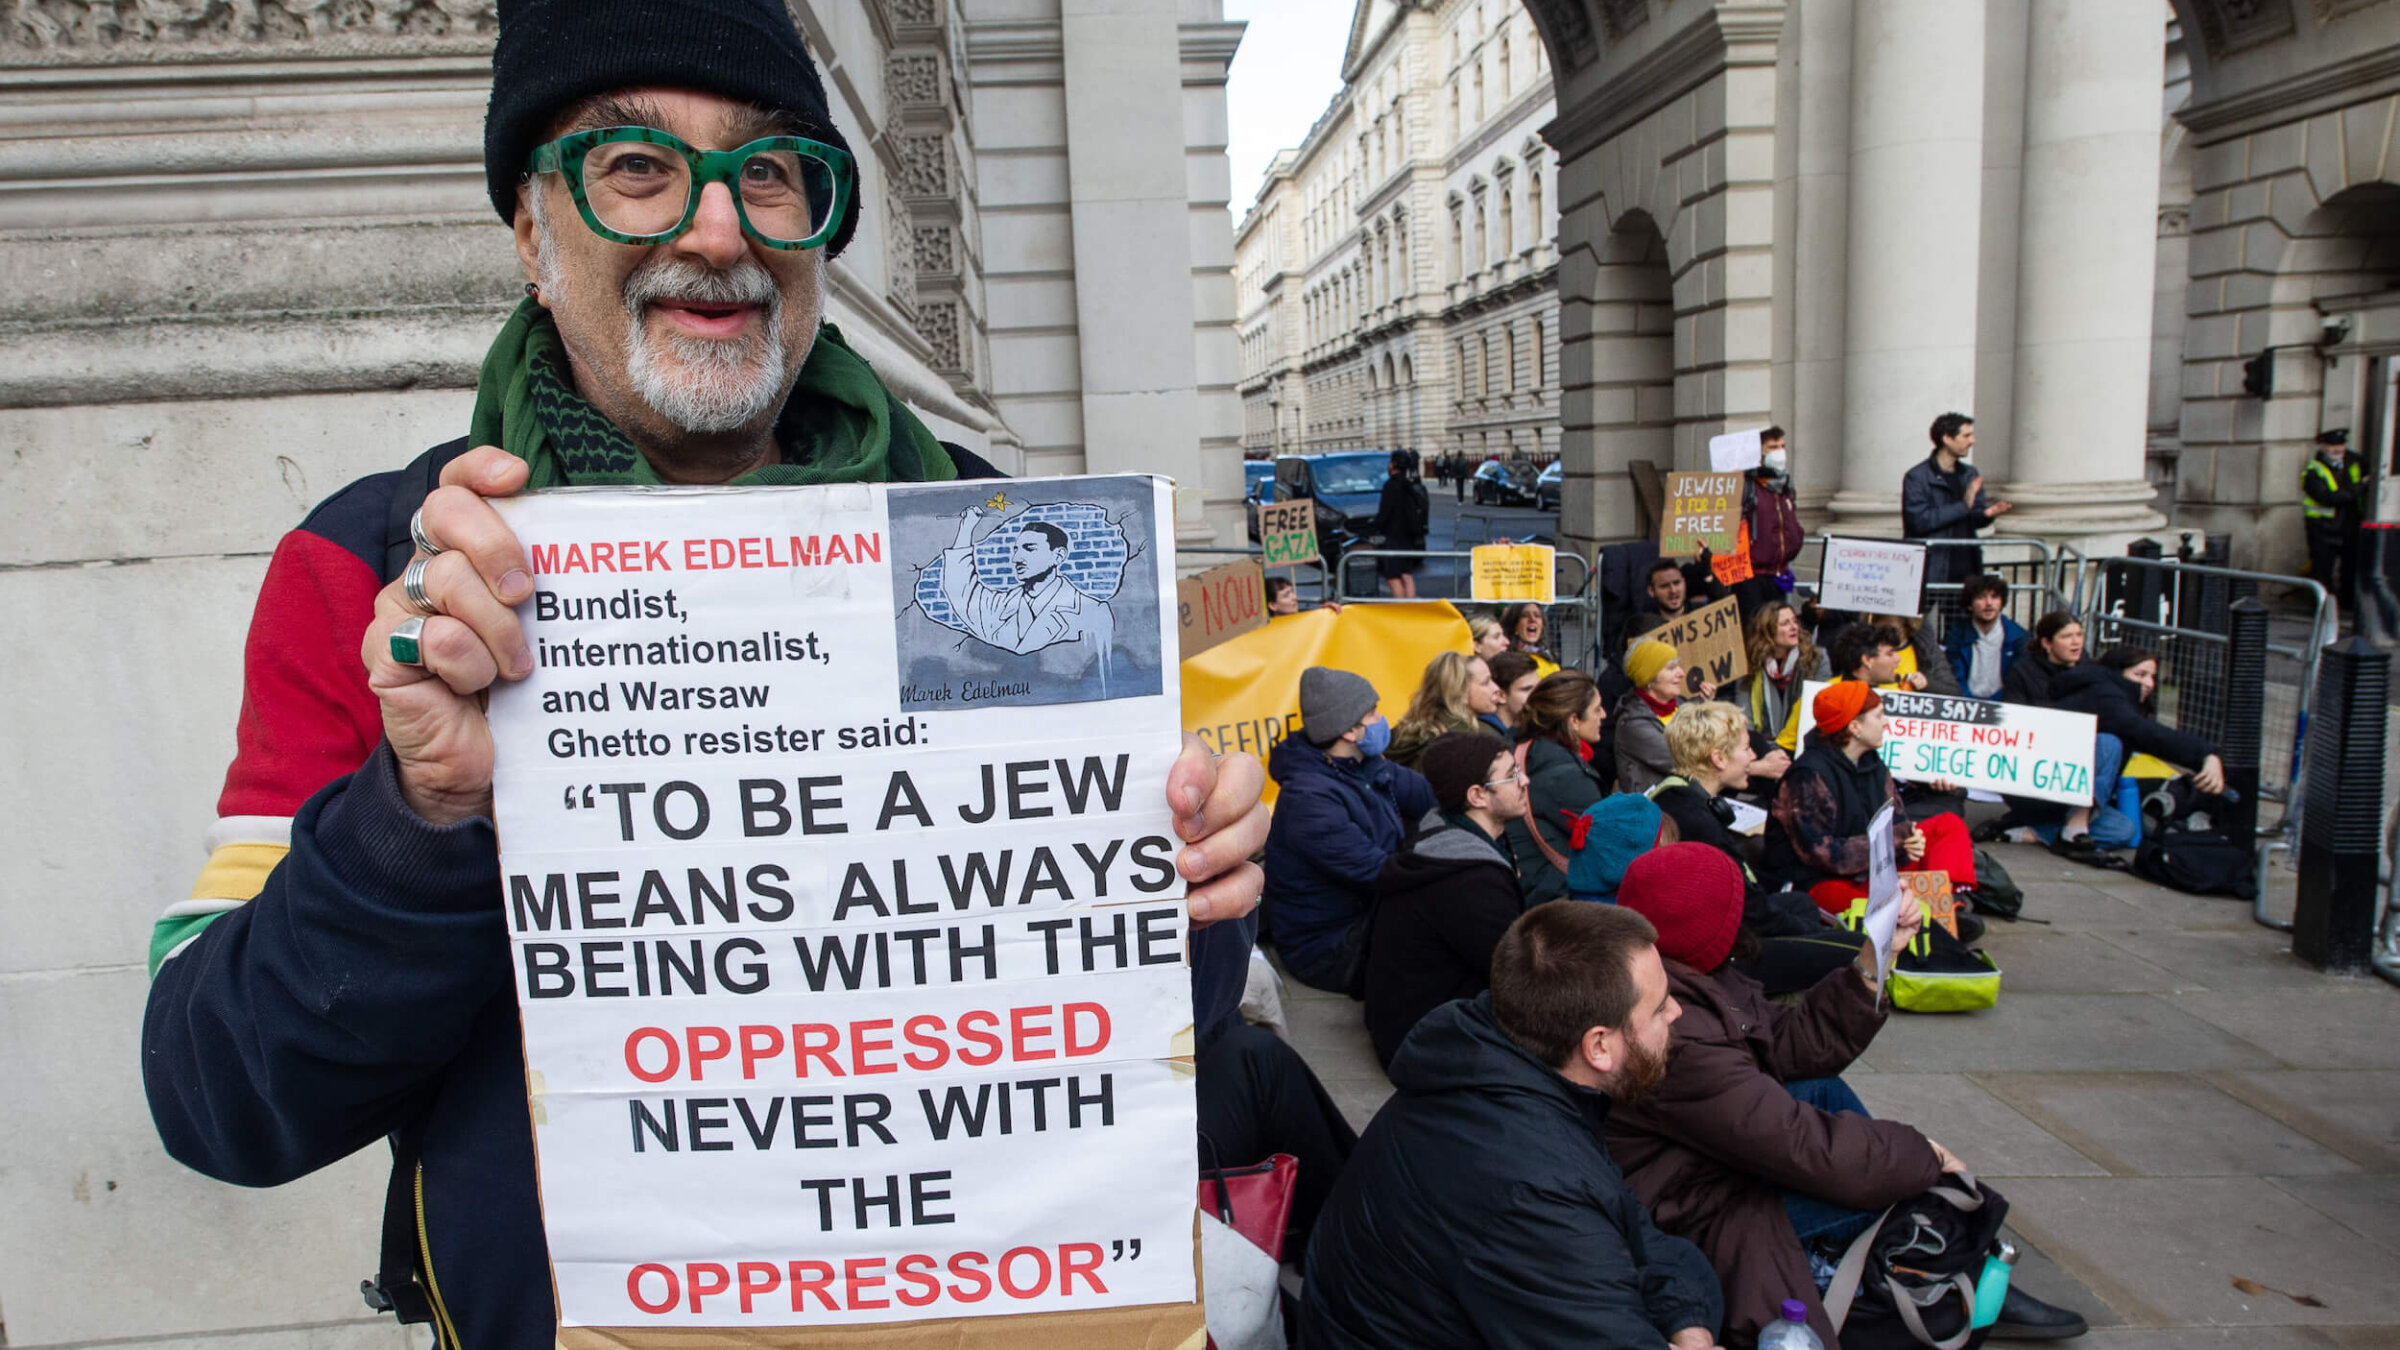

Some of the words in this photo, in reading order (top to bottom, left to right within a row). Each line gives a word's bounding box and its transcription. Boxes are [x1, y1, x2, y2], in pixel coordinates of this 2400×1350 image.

[1674, 477, 1736, 497] JEWISH
[1687, 497, 1709, 513] FOR
[1715, 497, 1727, 512] A
[1264, 505, 1309, 536] FREE
[1674, 515, 1725, 533] FREE
[531, 541, 671, 574] MAREK
[684, 533, 881, 570] EDELMAN
[1265, 529, 1317, 563] GAZA
[1666, 532, 1733, 552] PALETINE
[536, 587, 688, 624] Bundist,
[1202, 570, 1261, 636] NOW
[1657, 620, 1698, 647] EWS
[1703, 603, 1738, 638] SAY
[539, 631, 830, 667] internationalist,
[901, 684, 953, 703] Marek
[961, 680, 1032, 702] Edelman
[1686, 650, 1733, 694] OW
[543, 683, 609, 713] and
[620, 681, 769, 711] Warsaw
[1885, 693, 1935, 715] JEWS
[1941, 700, 1987, 721] SAY:
[547, 728, 671, 758] Ghetto
[684, 723, 825, 754] resister
[838, 716, 927, 750] said:
[1883, 718, 1959, 742] ASEFIRE
[1880, 741, 1905, 770] HE
[1914, 743, 1977, 778] SIEGE
[1987, 753, 2017, 782] ON
[2033, 759, 2090, 795] GAZA
[738, 774, 849, 838] BE
[875, 770, 934, 831] A
[957, 754, 1130, 824] JEW
[509, 863, 795, 933] MEANS
[832, 835, 1176, 921] ALWAYS
[523, 937, 770, 999] BEING
[793, 923, 998, 992] WITH
[1026, 907, 1182, 976] THE
[624, 1001, 1112, 1083] OPPRESSED
[628, 1092, 898, 1153] NEVER
[917, 1073, 1115, 1141] WITH
[800, 1169, 956, 1232] THE
